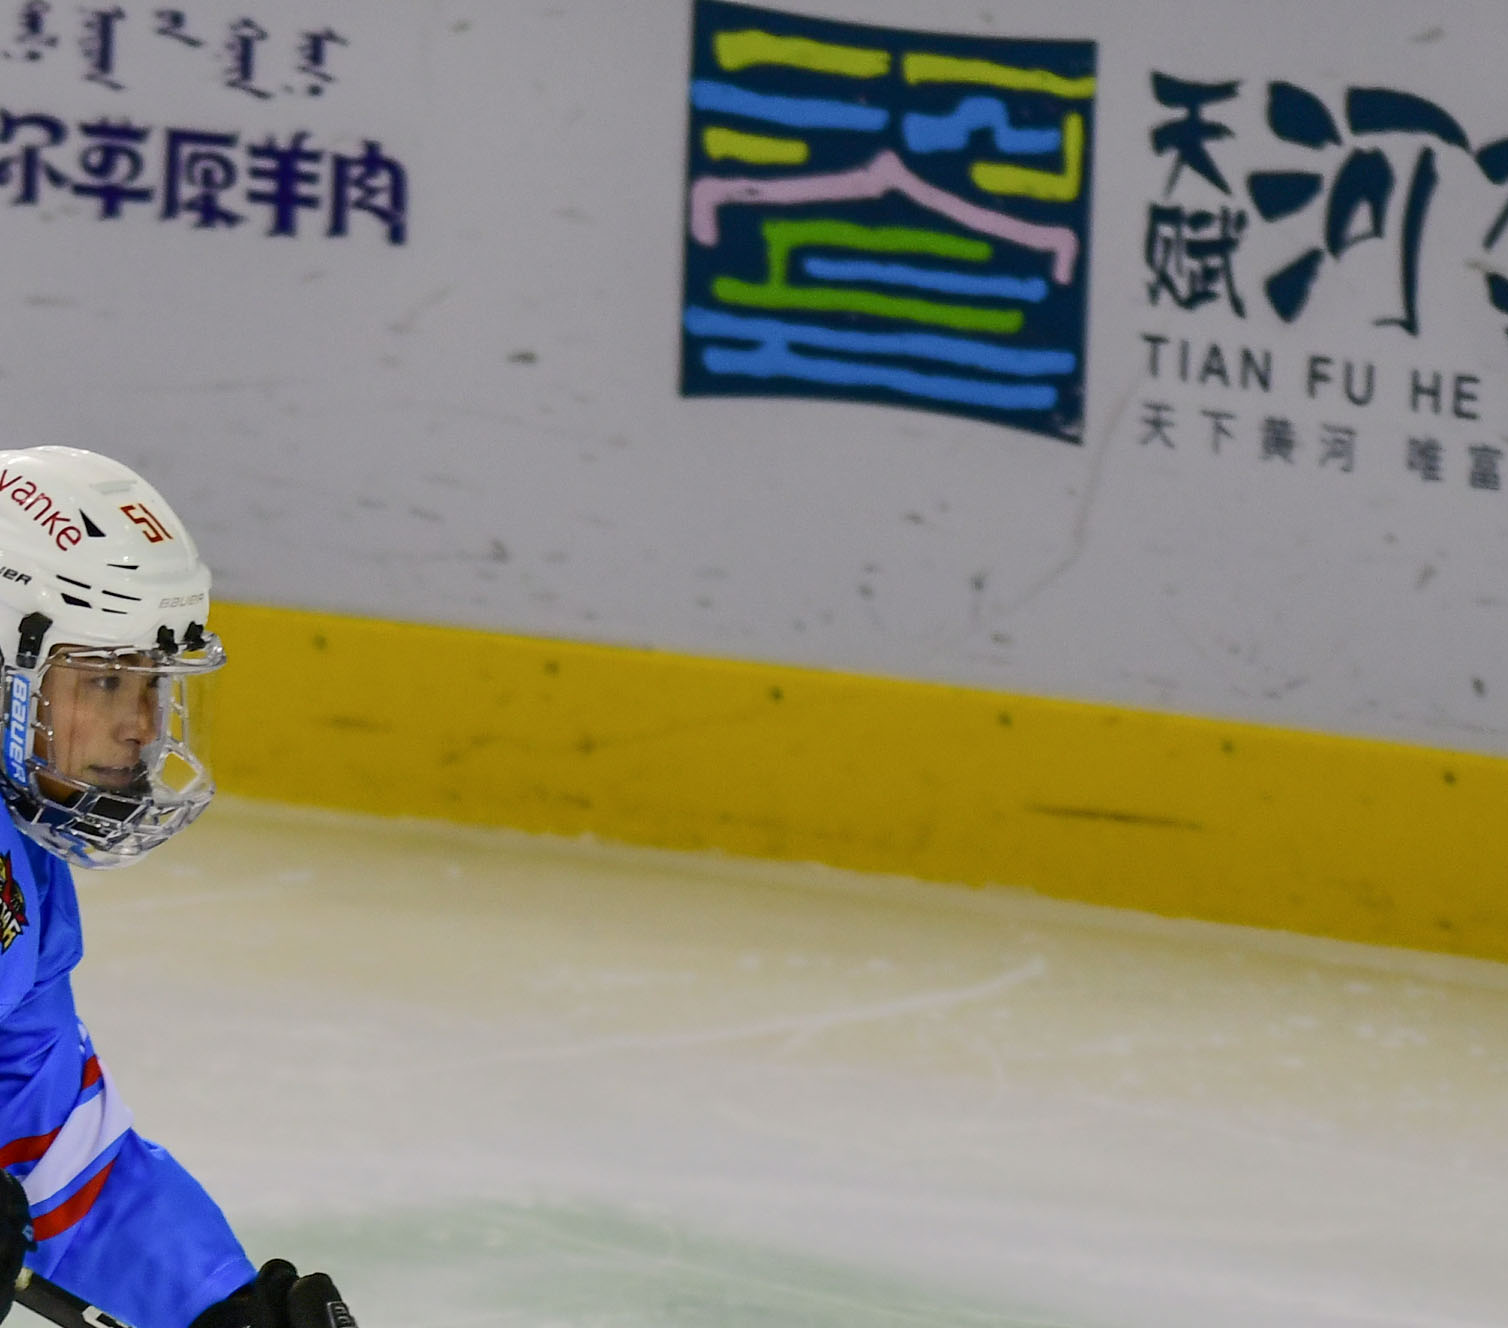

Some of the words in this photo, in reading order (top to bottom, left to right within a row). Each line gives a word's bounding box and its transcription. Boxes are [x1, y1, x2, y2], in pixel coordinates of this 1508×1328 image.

[1140, 332, 1273, 394] TIAN
[1306, 353, 1376, 407] FU
[1408, 368, 1482, 421] HE
